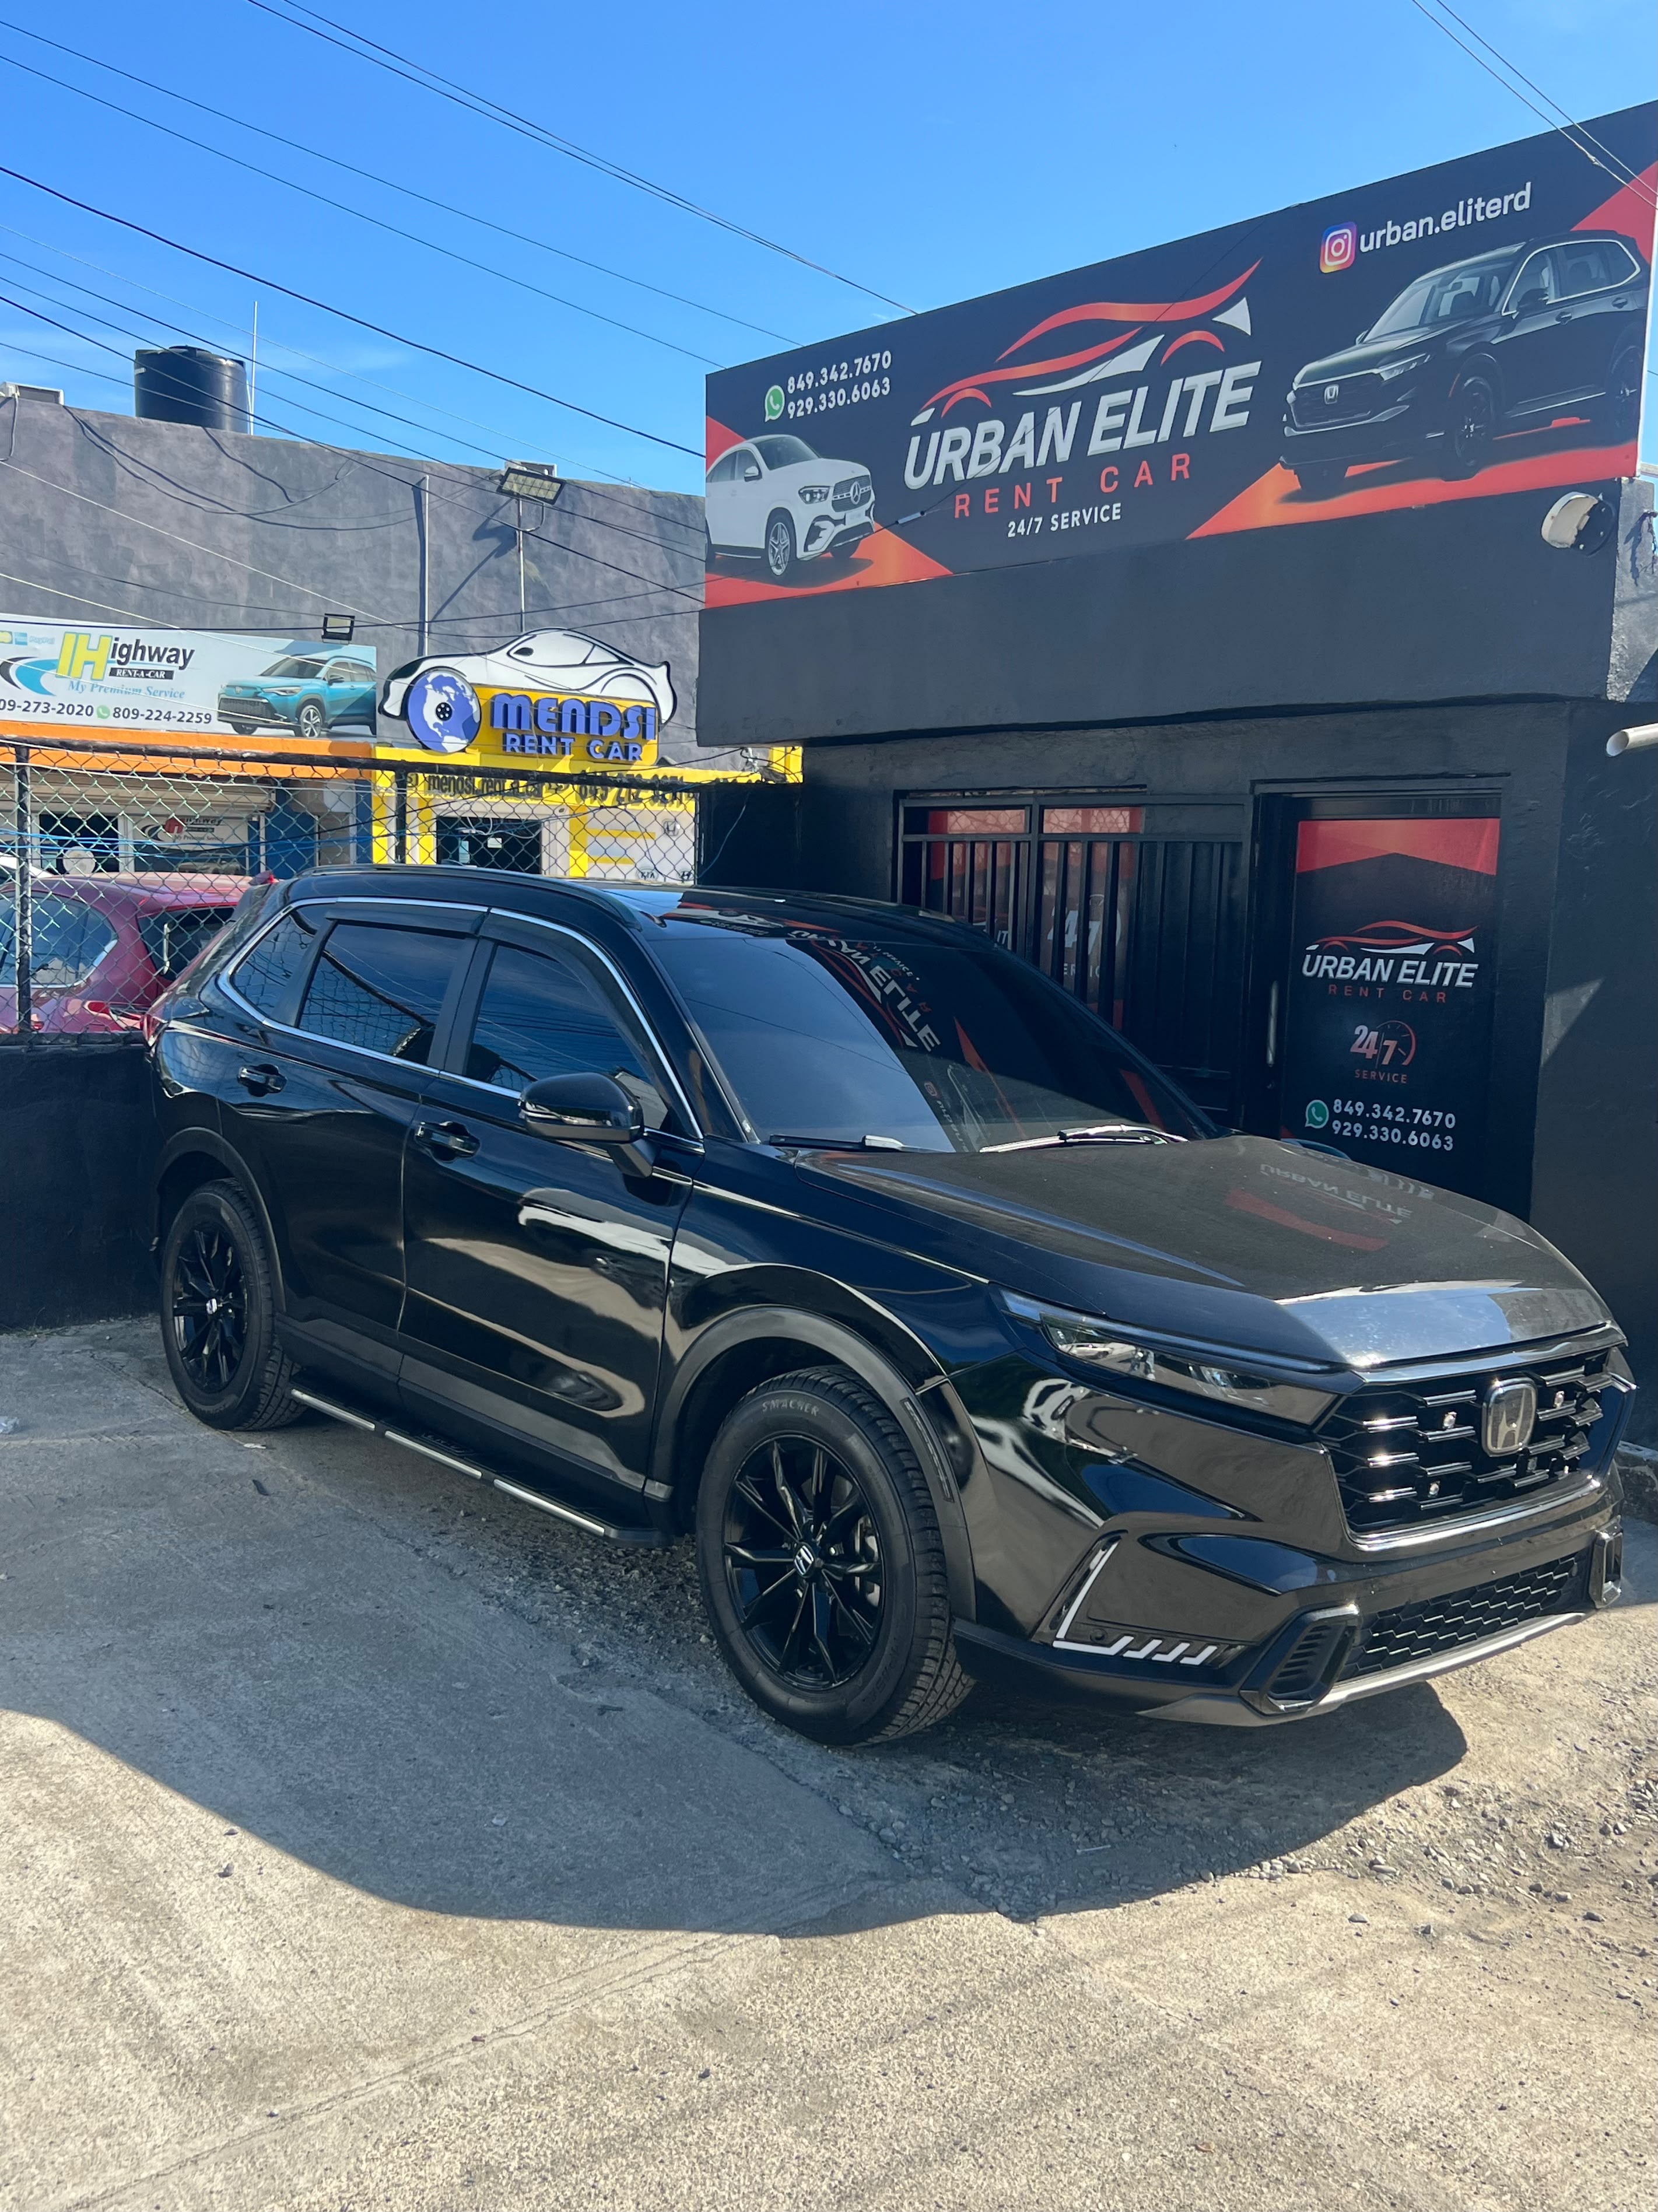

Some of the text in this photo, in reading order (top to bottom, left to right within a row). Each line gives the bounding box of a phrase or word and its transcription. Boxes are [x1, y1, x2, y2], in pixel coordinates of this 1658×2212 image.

[1359, 181, 1532, 253] urban.eliterd
[786, 350, 892, 394] 849.342.7670
[787, 377, 891, 420] 929.330.6063
[903, 361, 1262, 489] URBAN ELITE
[954, 453, 1190, 518] RENT CAR
[1007, 502, 1121, 538] 24/7 SERVICE
[116, 668, 165, 678] RENT-A-CAR
[68, 681, 185, 699] My Premium Service
[113, 707, 212, 724] 809-224-2259
[503, 732, 643, 761] RENT CAR
[1302, 955, 1479, 988] URBAN ELITE
[1328, 984, 1447, 1003] RENT CAR
[1354, 1068, 1408, 1084] SERVICE
[1333, 1099, 1456, 1128] 849.342.7670
[1332, 1120, 1453, 1151] 929.330.6063
